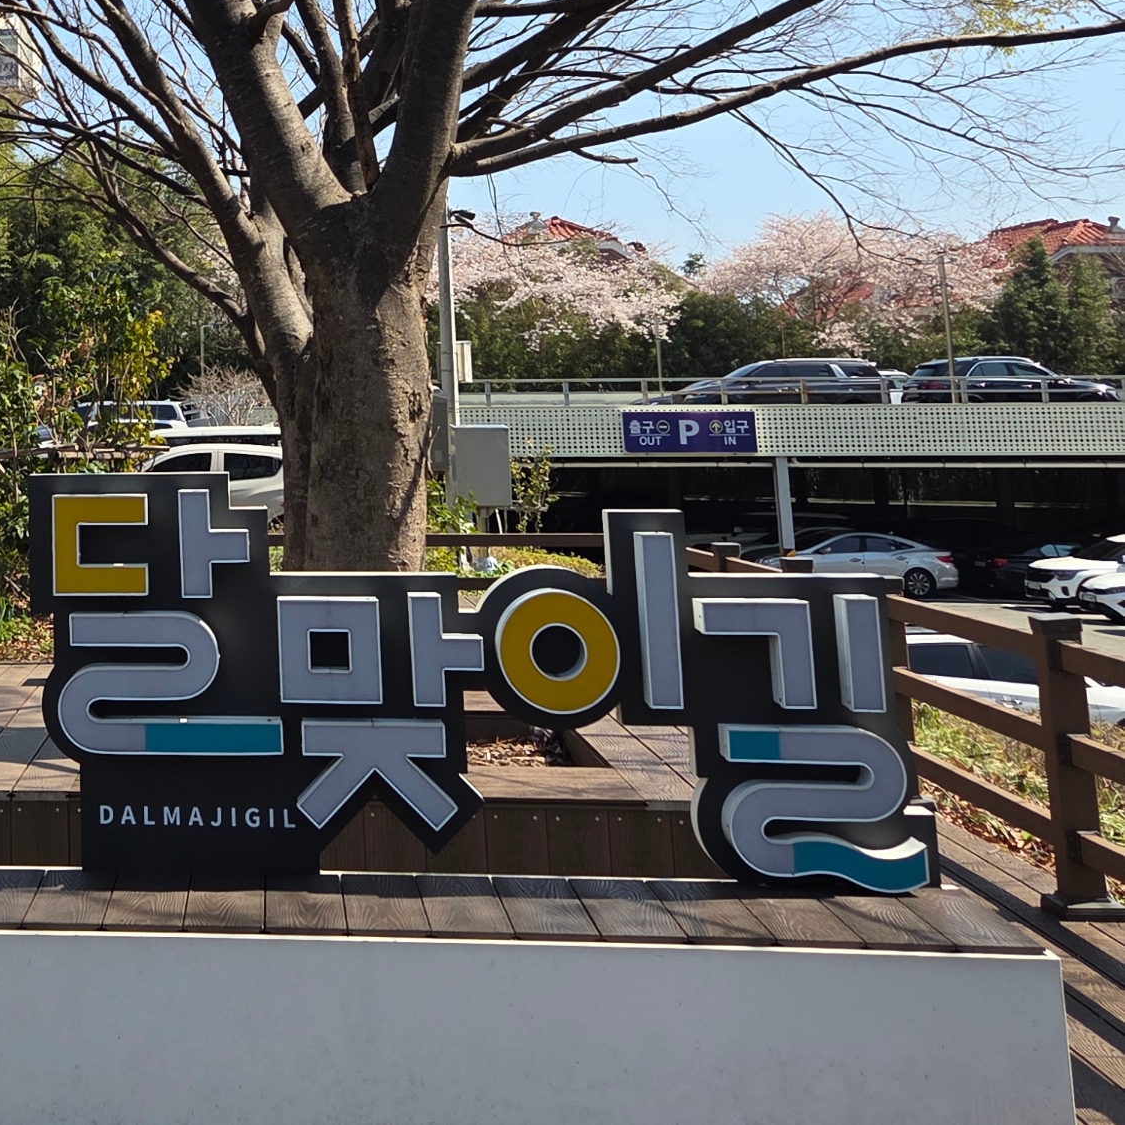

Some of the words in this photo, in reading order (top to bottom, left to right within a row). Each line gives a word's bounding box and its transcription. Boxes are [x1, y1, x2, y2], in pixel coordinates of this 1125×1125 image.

[629, 420, 655, 434] 출구
[678, 419, 700, 445] P
[723, 419, 750, 434] 입구
[639, 436, 662, 446] OUT
[724, 436, 737, 446] IN
[51, 487, 930, 894] 달맞이길
[99, 804, 296, 828] DALMAJIGIL
